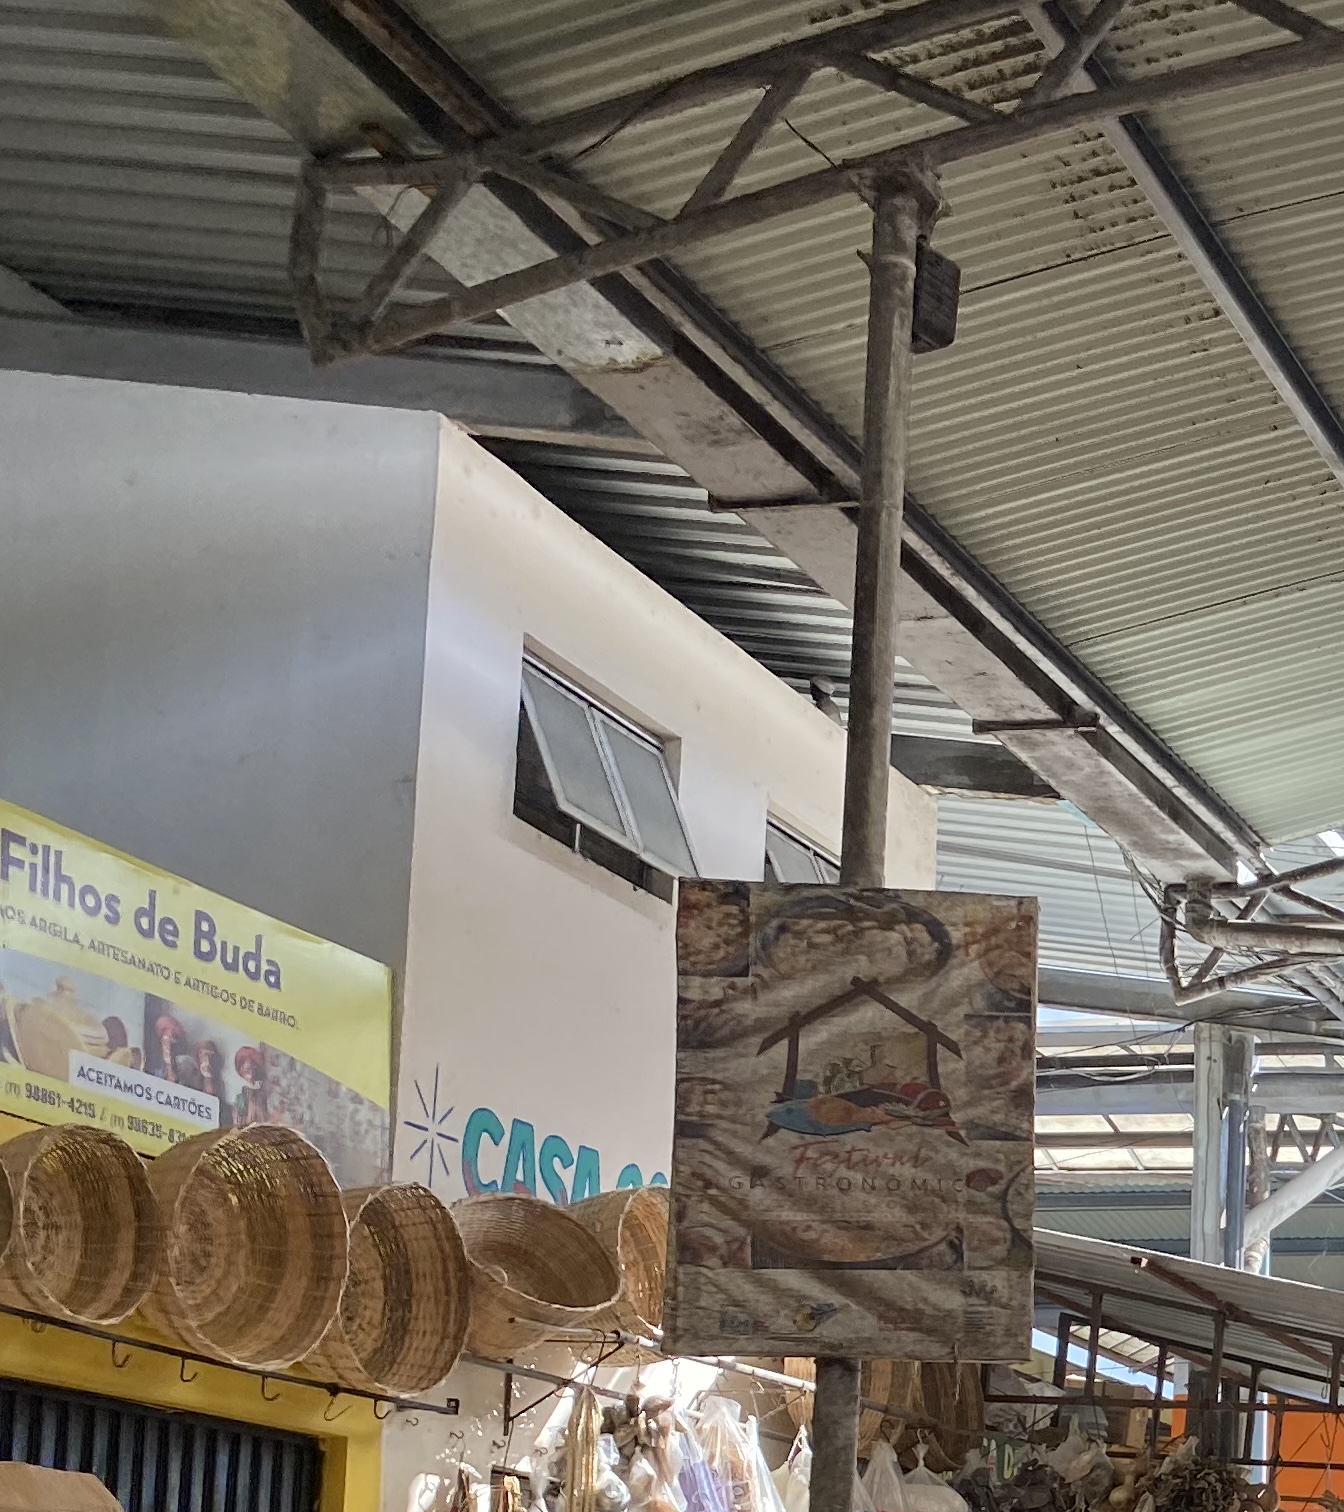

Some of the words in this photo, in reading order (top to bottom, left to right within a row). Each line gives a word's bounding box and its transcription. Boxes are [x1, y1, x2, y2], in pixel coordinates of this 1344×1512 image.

[1, 827, 121, 926] Filhos
[134, 889, 180, 950] de
[194, 909, 282, 992] Buda
[88, 938, 171, 980] ARTESANATO
[184, 976, 237, 1007] ARTIGOS
[239, 994, 255, 1014] DE
[77, 1065, 152, 1101] ACEITAMOS
[156, 1089, 212, 1121] CARTÕES
[462, 1107, 600, 1210] CASA
